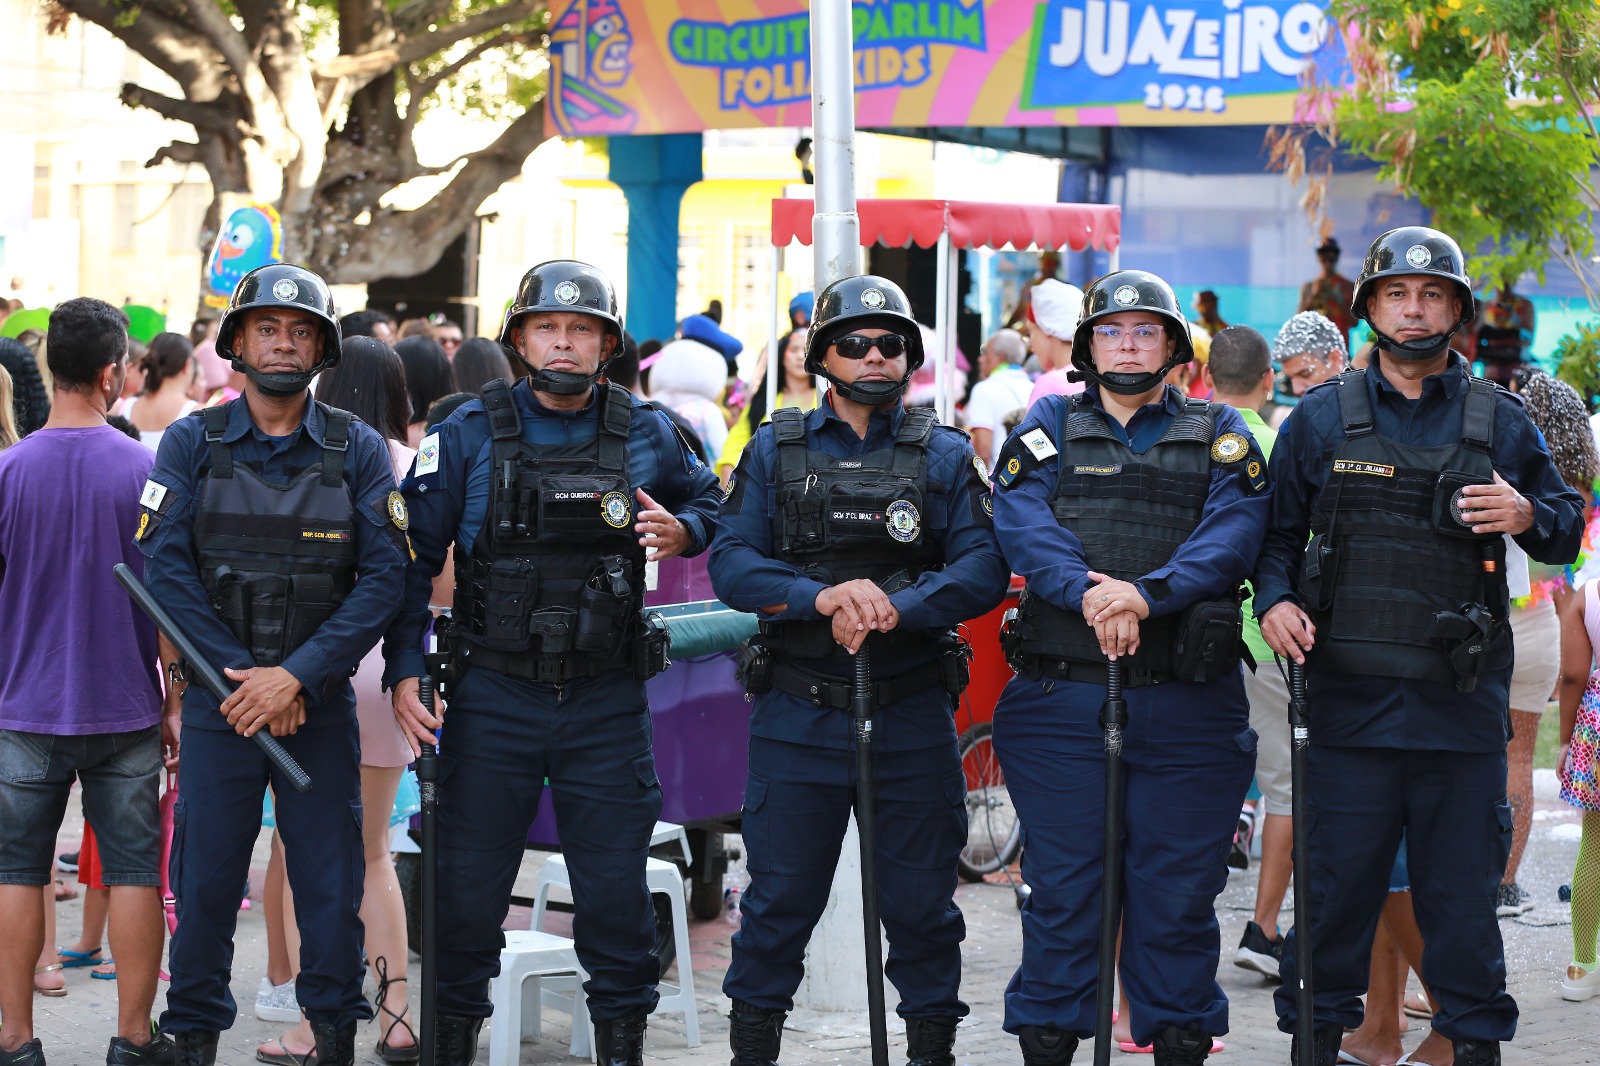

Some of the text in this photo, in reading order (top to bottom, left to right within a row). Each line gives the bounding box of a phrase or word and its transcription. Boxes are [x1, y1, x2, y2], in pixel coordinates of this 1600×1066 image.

[671, 2, 981, 62] CIRCUIT PARLIM
[724, 60, 812, 105] FOLI
[1143, 82, 1226, 111] 2026
[554, 492, 569, 500] GCM
[858, 512, 872, 520] BRAZ
